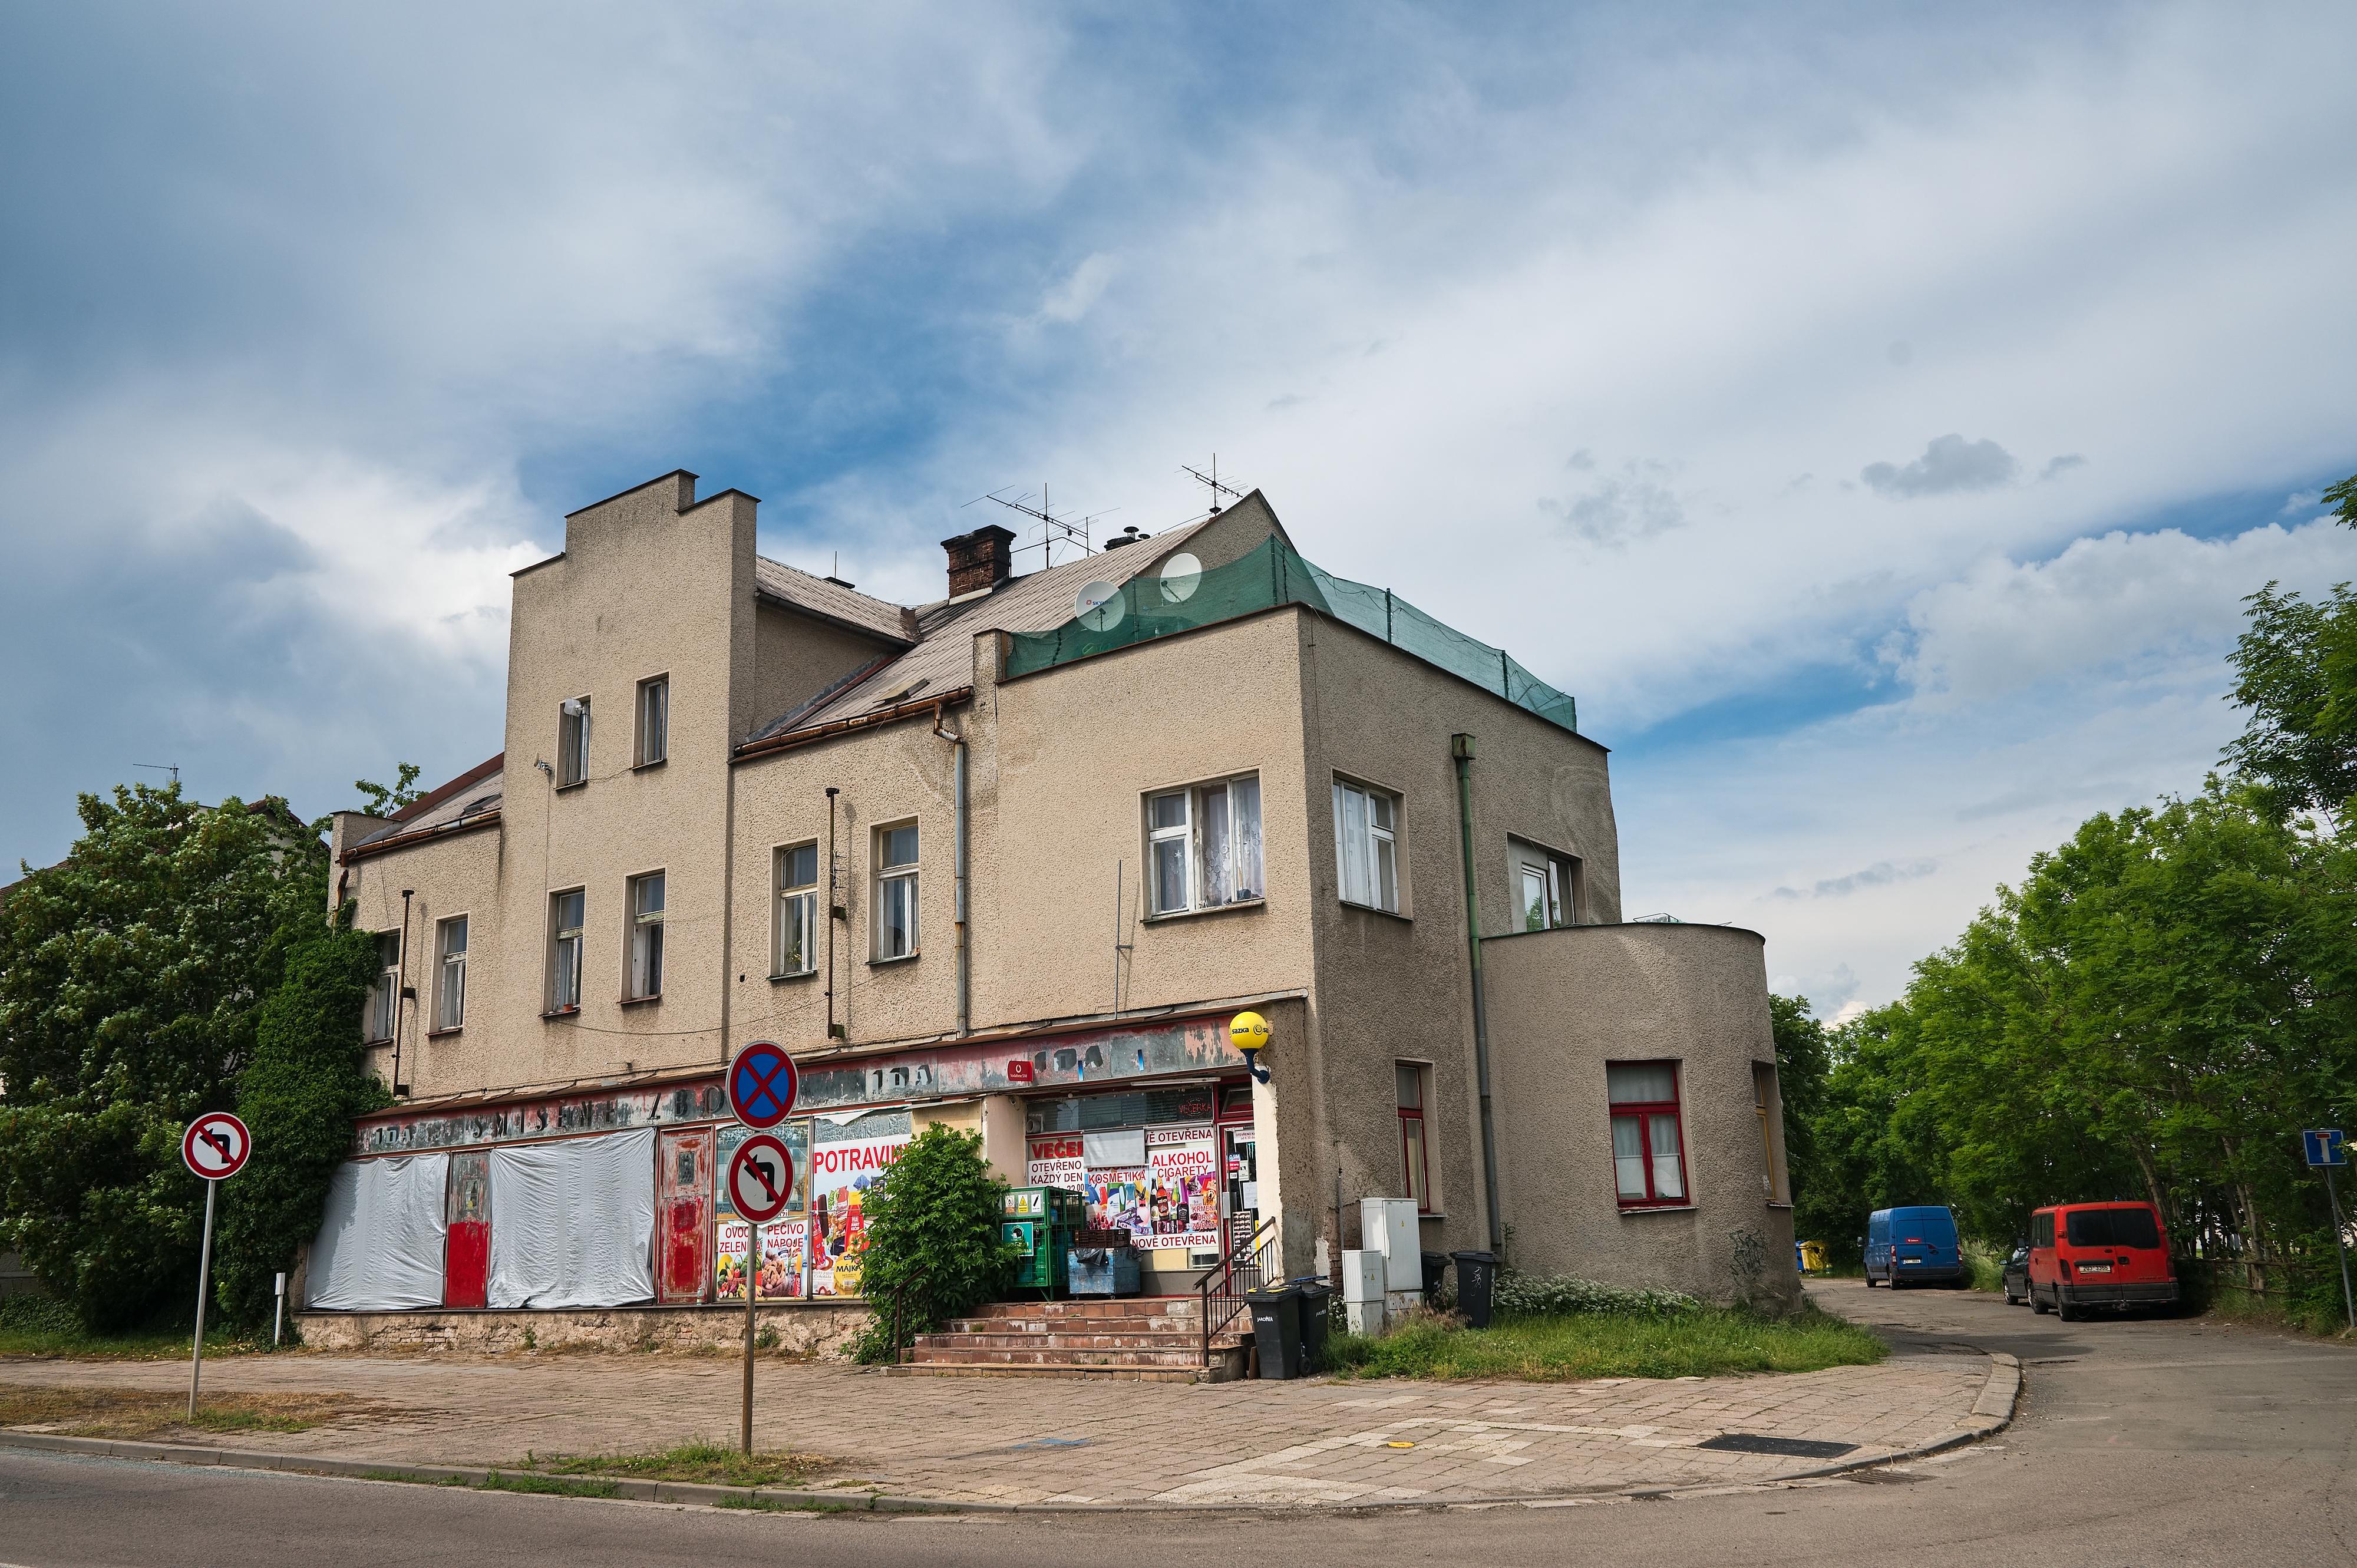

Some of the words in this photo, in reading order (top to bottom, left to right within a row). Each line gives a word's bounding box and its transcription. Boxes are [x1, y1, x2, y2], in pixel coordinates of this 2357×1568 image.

[1158, 1128, 1213, 1142] OTEVŘENA
[1152, 1151, 1213, 1167] ALKOHOL
[1032, 1160, 1081, 1173] OTEVŘENO
[1157, 1165, 1209, 1178] CIGARETY
[1031, 1171, 1061, 1184] KAŽDÝ
[1064, 1173, 1082, 1182] DEN
[1088, 1169, 1146, 1184] KOSMETIKA
[725, 1227, 748, 1239] OVOC
[767, 1223, 804, 1236] PEČIVO
[767, 1236, 804, 1249] NÁPOJE
[1132, 1235, 1158, 1248] NOVĚ
[1161, 1233, 1217, 1247] OTEVŘENA
